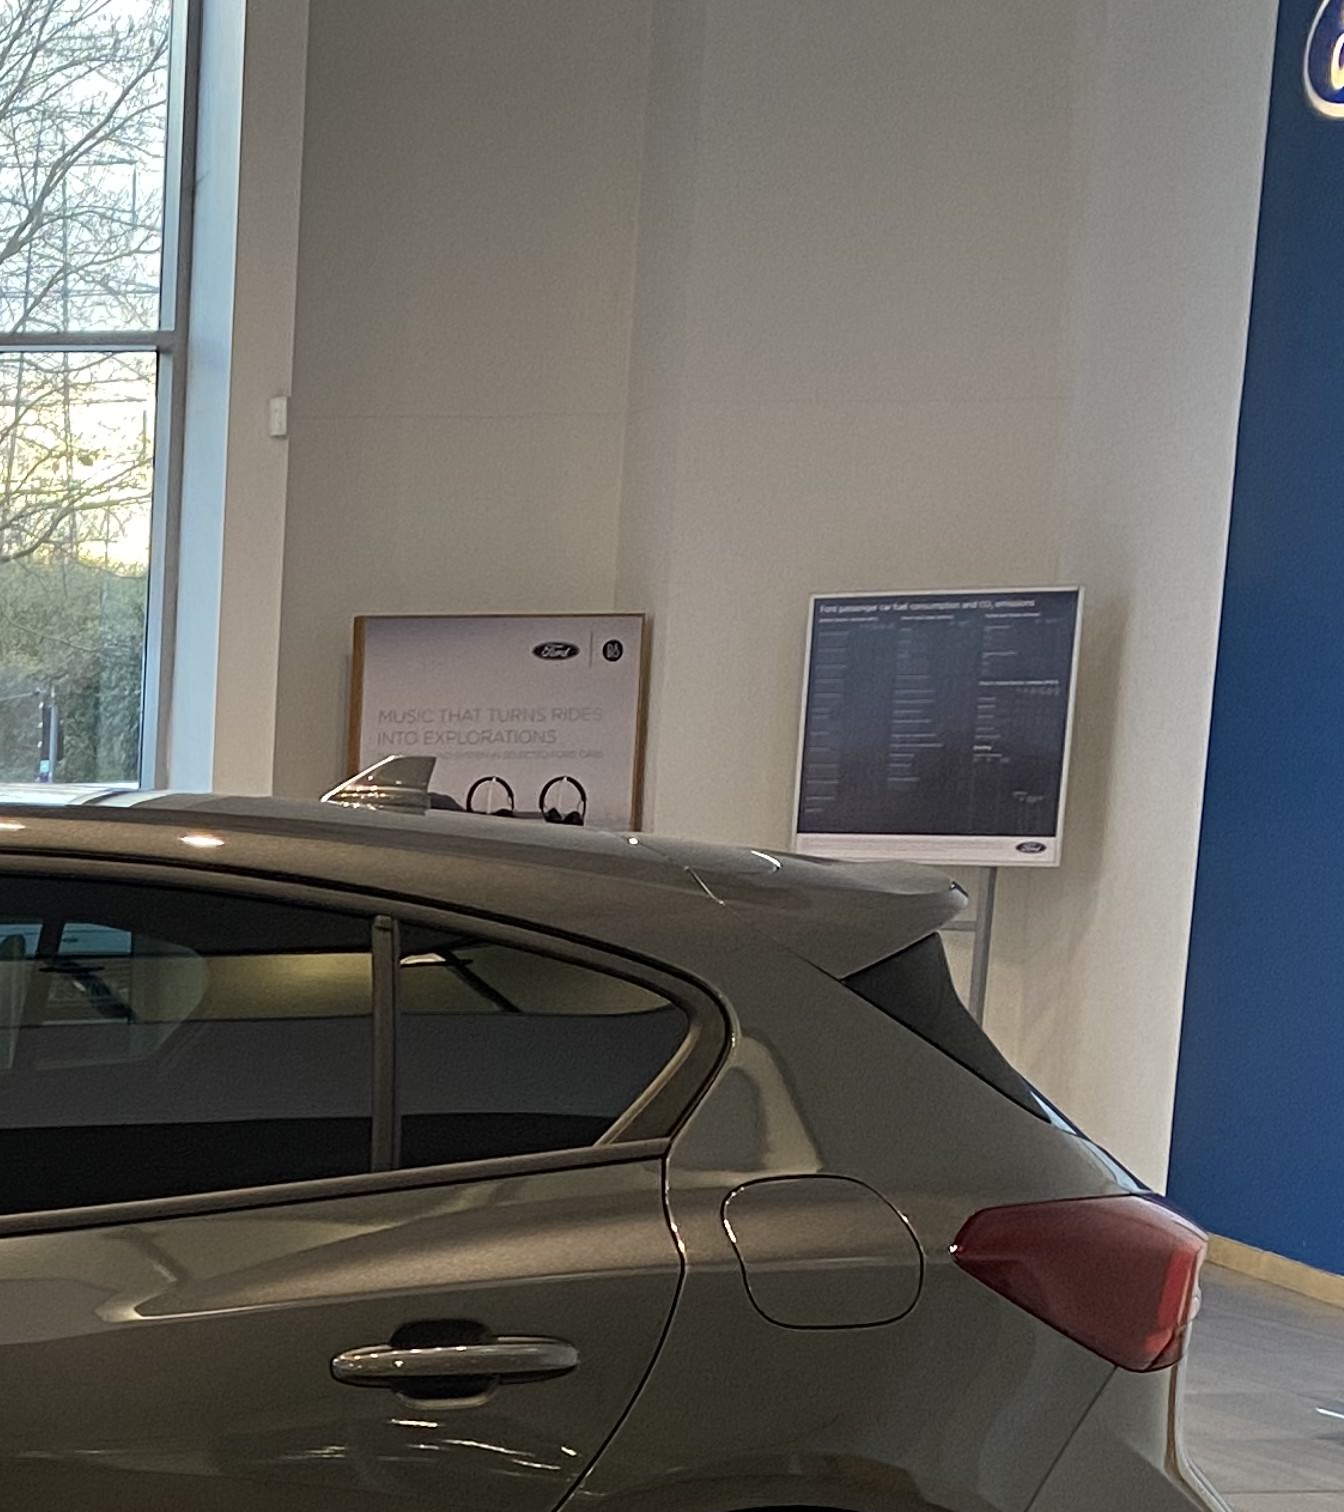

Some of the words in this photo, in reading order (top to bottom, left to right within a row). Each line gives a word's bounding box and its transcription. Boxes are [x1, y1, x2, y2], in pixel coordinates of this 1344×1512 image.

[377, 709, 435, 724] MUSIC
[438, 708, 482, 723] THAT
[487, 707, 547, 722] TURNS
[551, 707, 603, 721] RIDES
[376, 731, 418, 746] INTO
[423, 729, 558, 746] EXPLORATIONS
